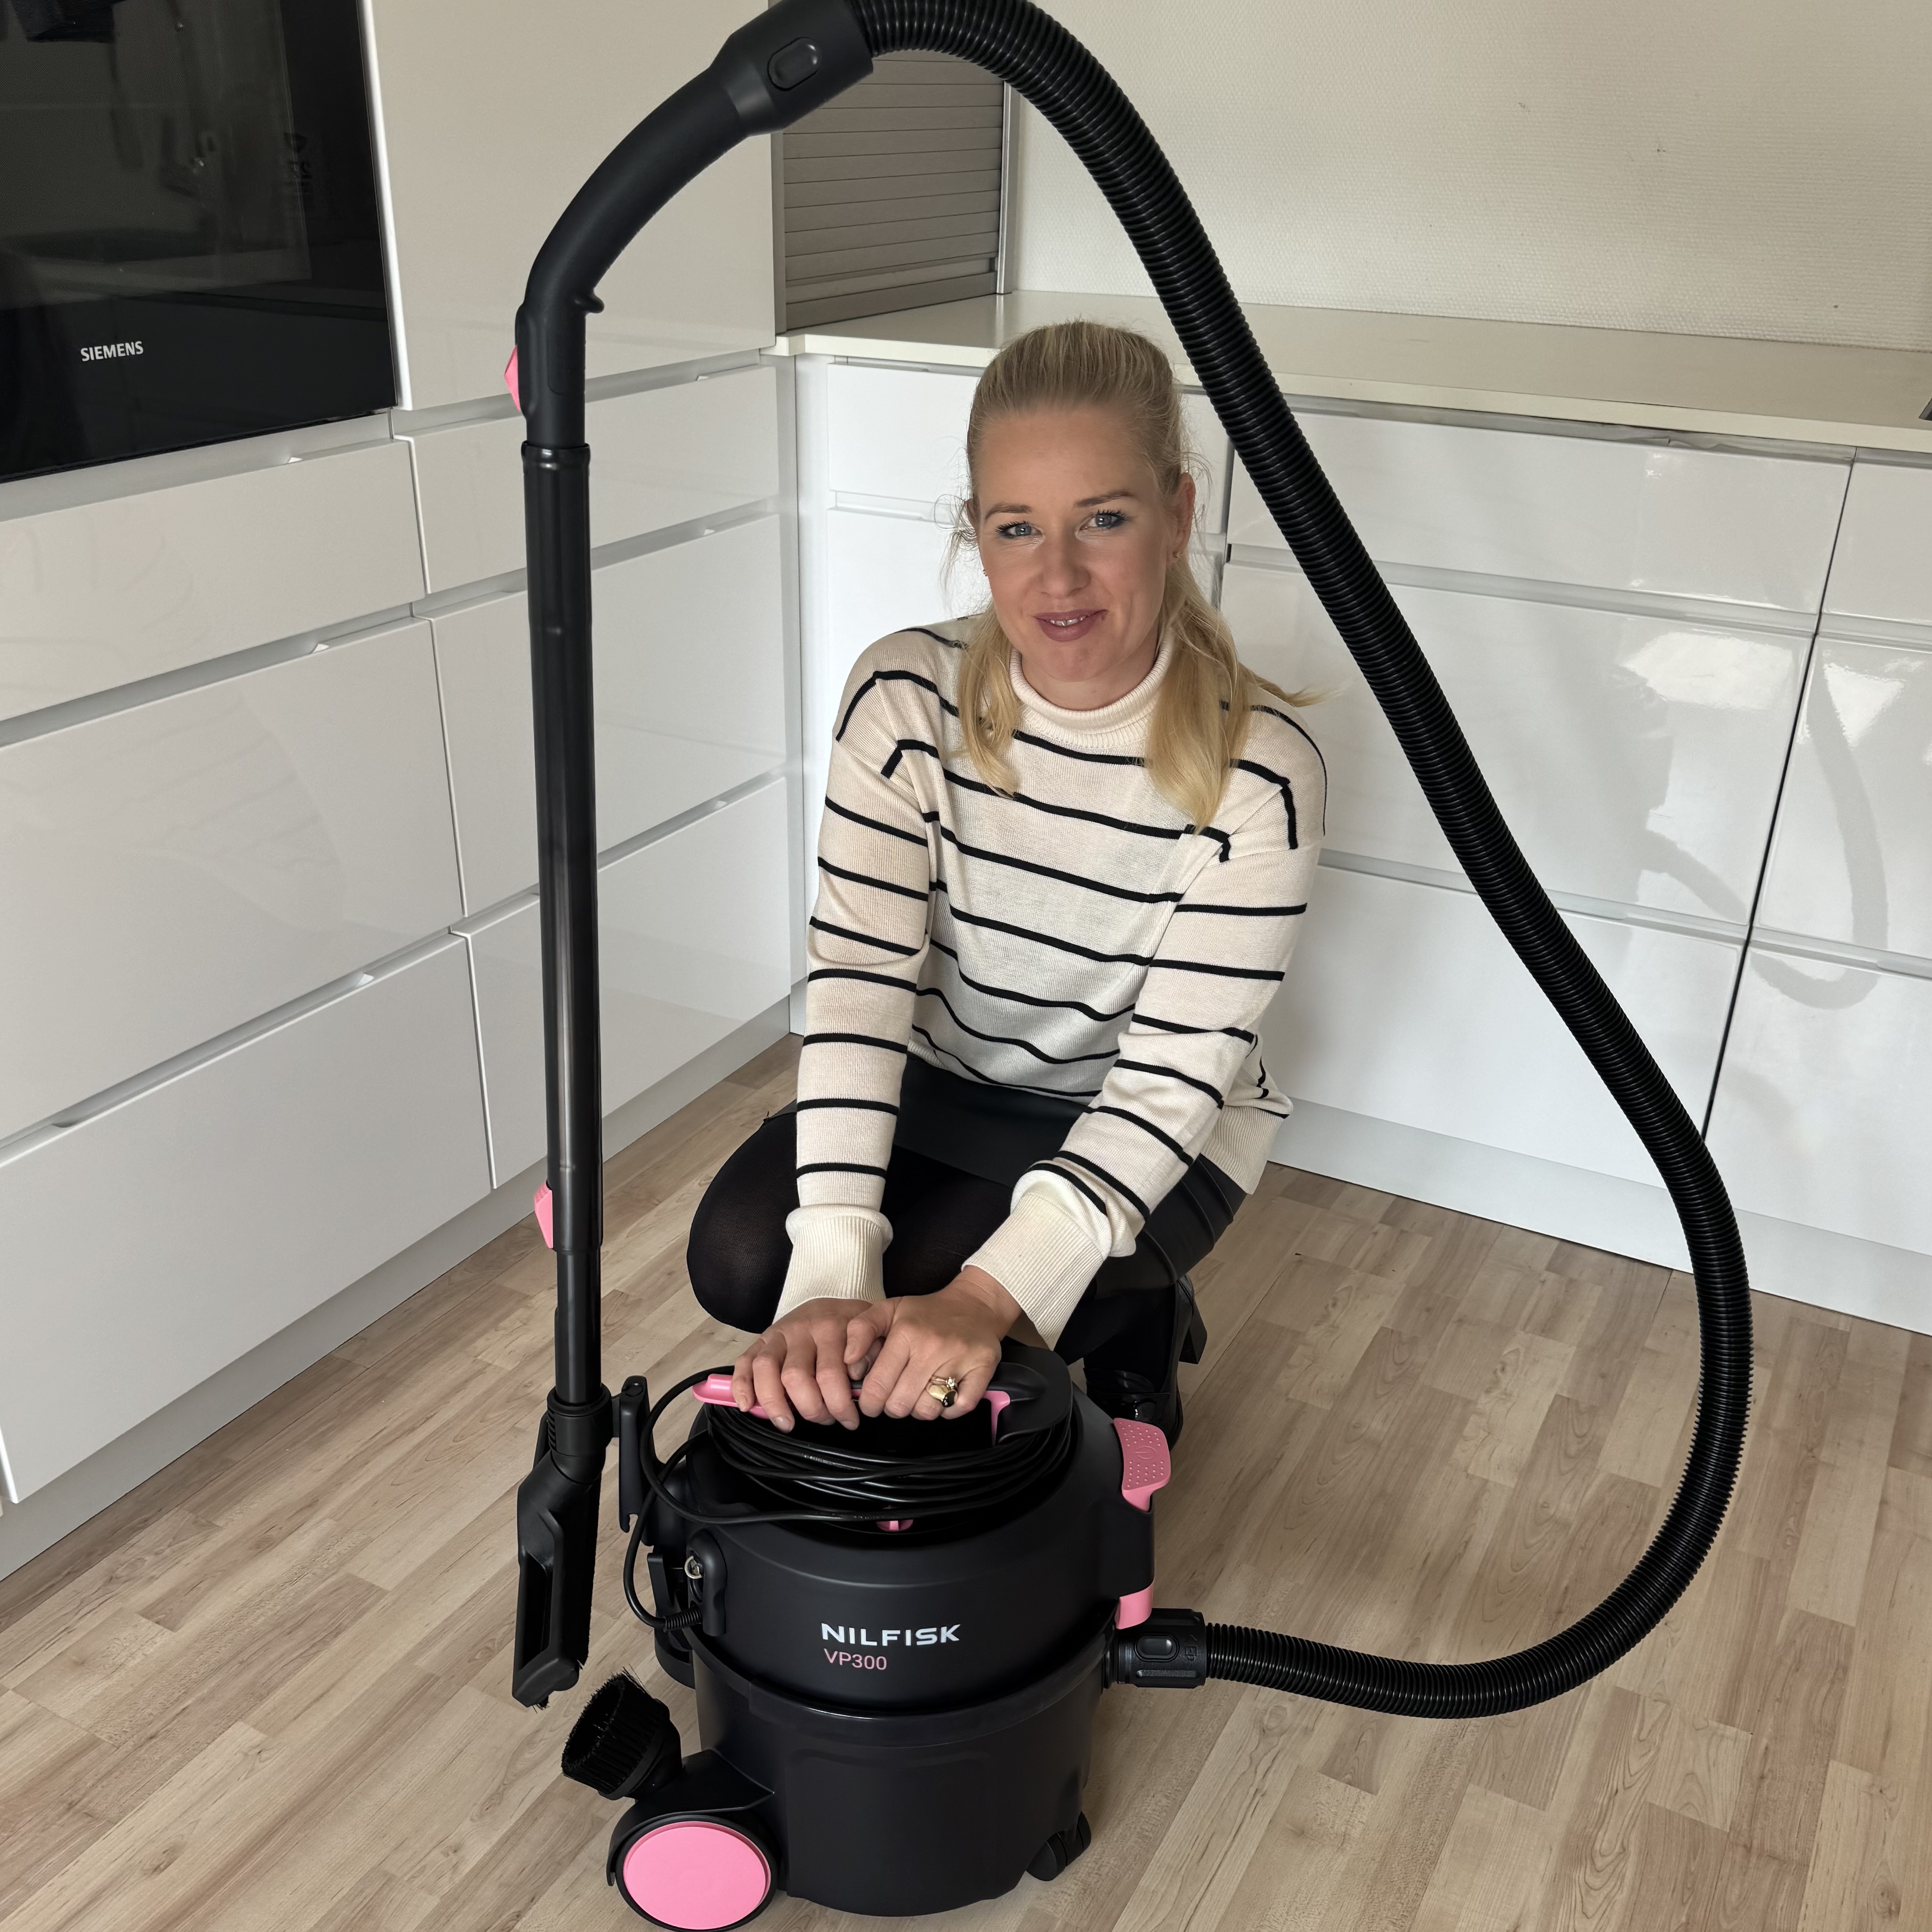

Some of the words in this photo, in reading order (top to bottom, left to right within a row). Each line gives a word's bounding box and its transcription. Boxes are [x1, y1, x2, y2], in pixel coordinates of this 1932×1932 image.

[80, 341, 144, 362] SIEMENS
[821, 1622, 960, 1646] NILFISK
[823, 1648, 887, 1670] VP300
